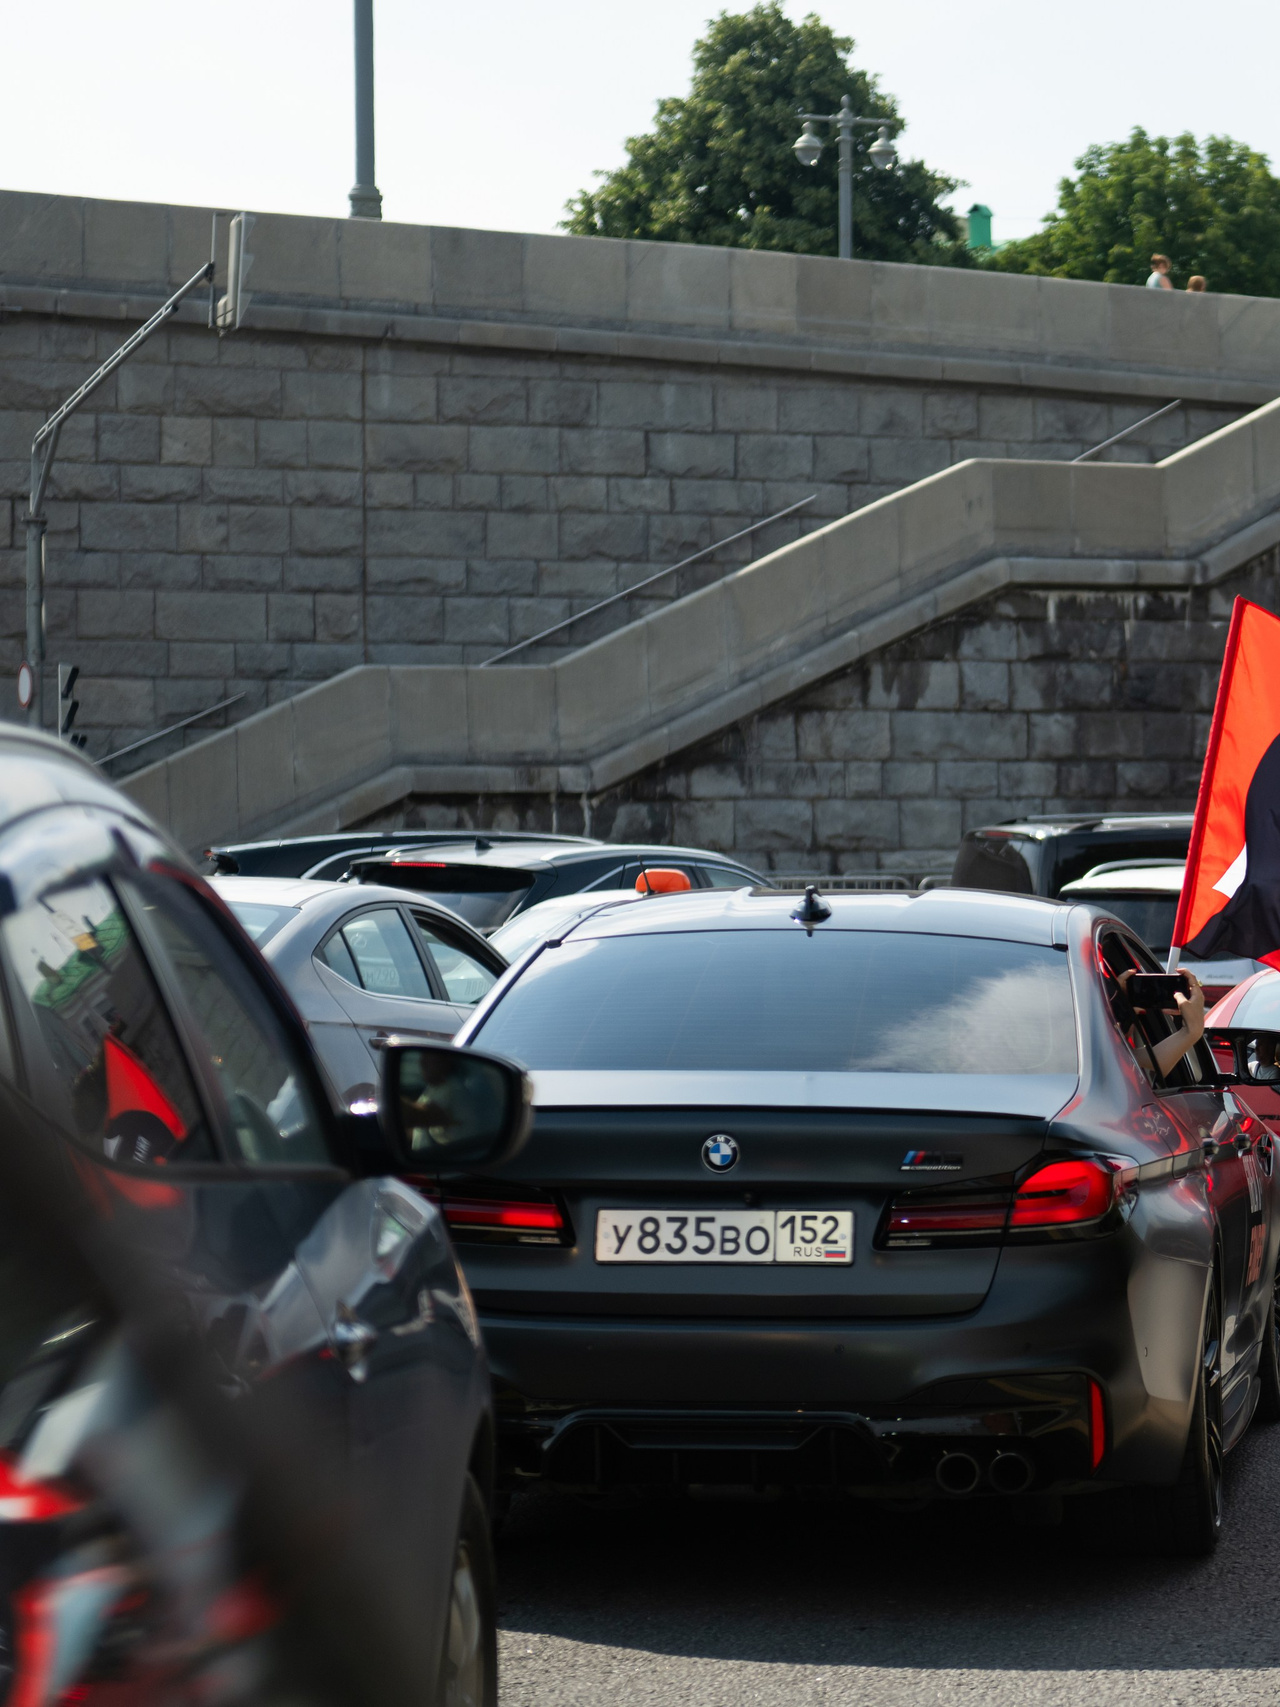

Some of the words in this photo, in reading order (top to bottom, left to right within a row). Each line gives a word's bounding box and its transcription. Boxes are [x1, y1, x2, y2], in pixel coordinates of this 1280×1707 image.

[707, 1136, 737, 1149] BMW
[611, 1216, 771, 1256] У835ВО
[780, 1215, 840, 1245] 152
[793, 1246, 823, 1258] RUS
